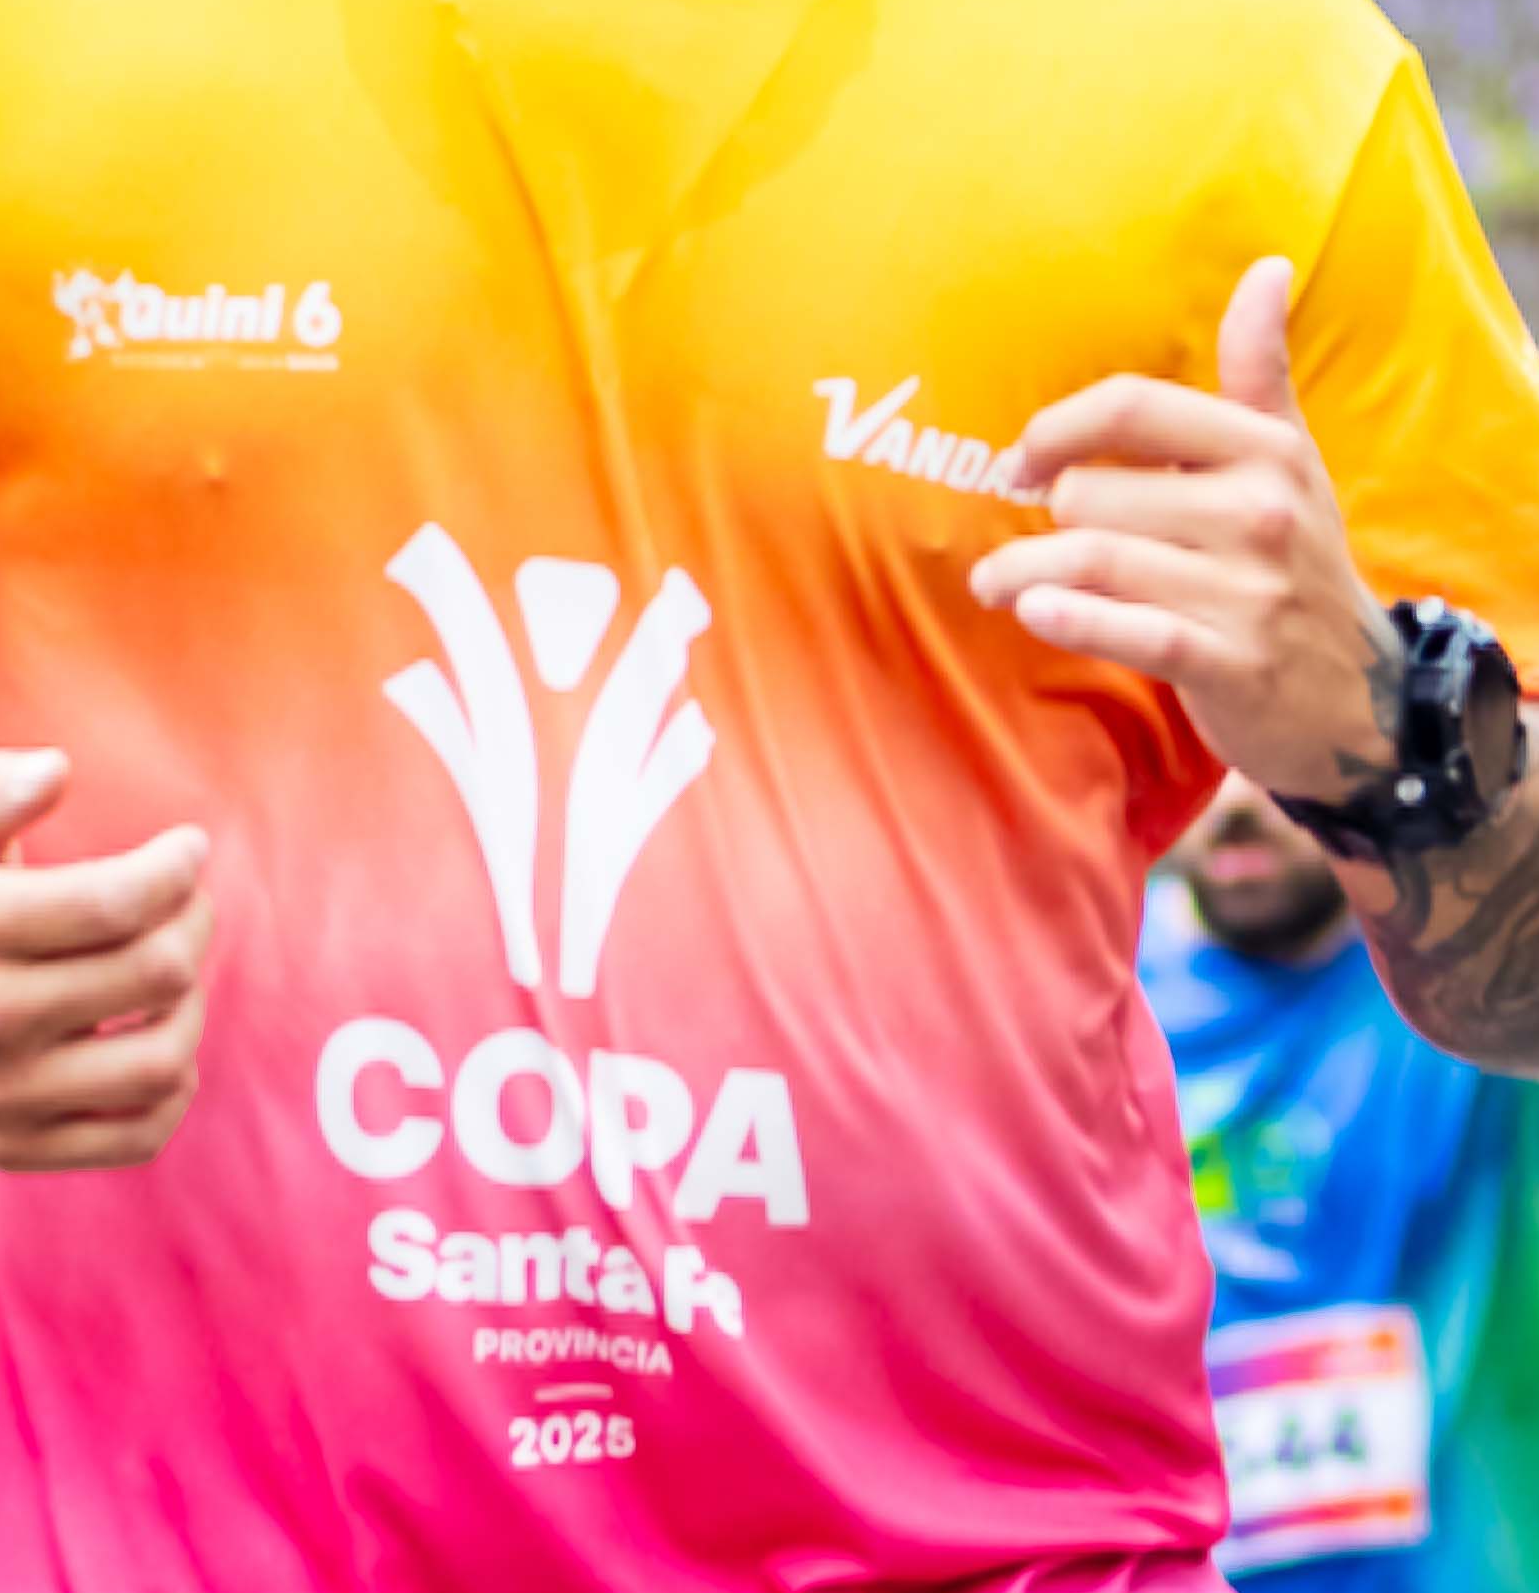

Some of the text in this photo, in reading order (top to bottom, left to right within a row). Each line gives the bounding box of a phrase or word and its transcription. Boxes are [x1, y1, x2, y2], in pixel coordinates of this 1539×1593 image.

[293, 280, 342, 348] 6
[812, 374, 1053, 507] VANDA
[316, 1016, 810, 1226] COPA
[367, 1209, 657, 1316] Santa
[472, 1325, 674, 1377] PROVINCIA
[507, 1409, 637, 1468] 2025
